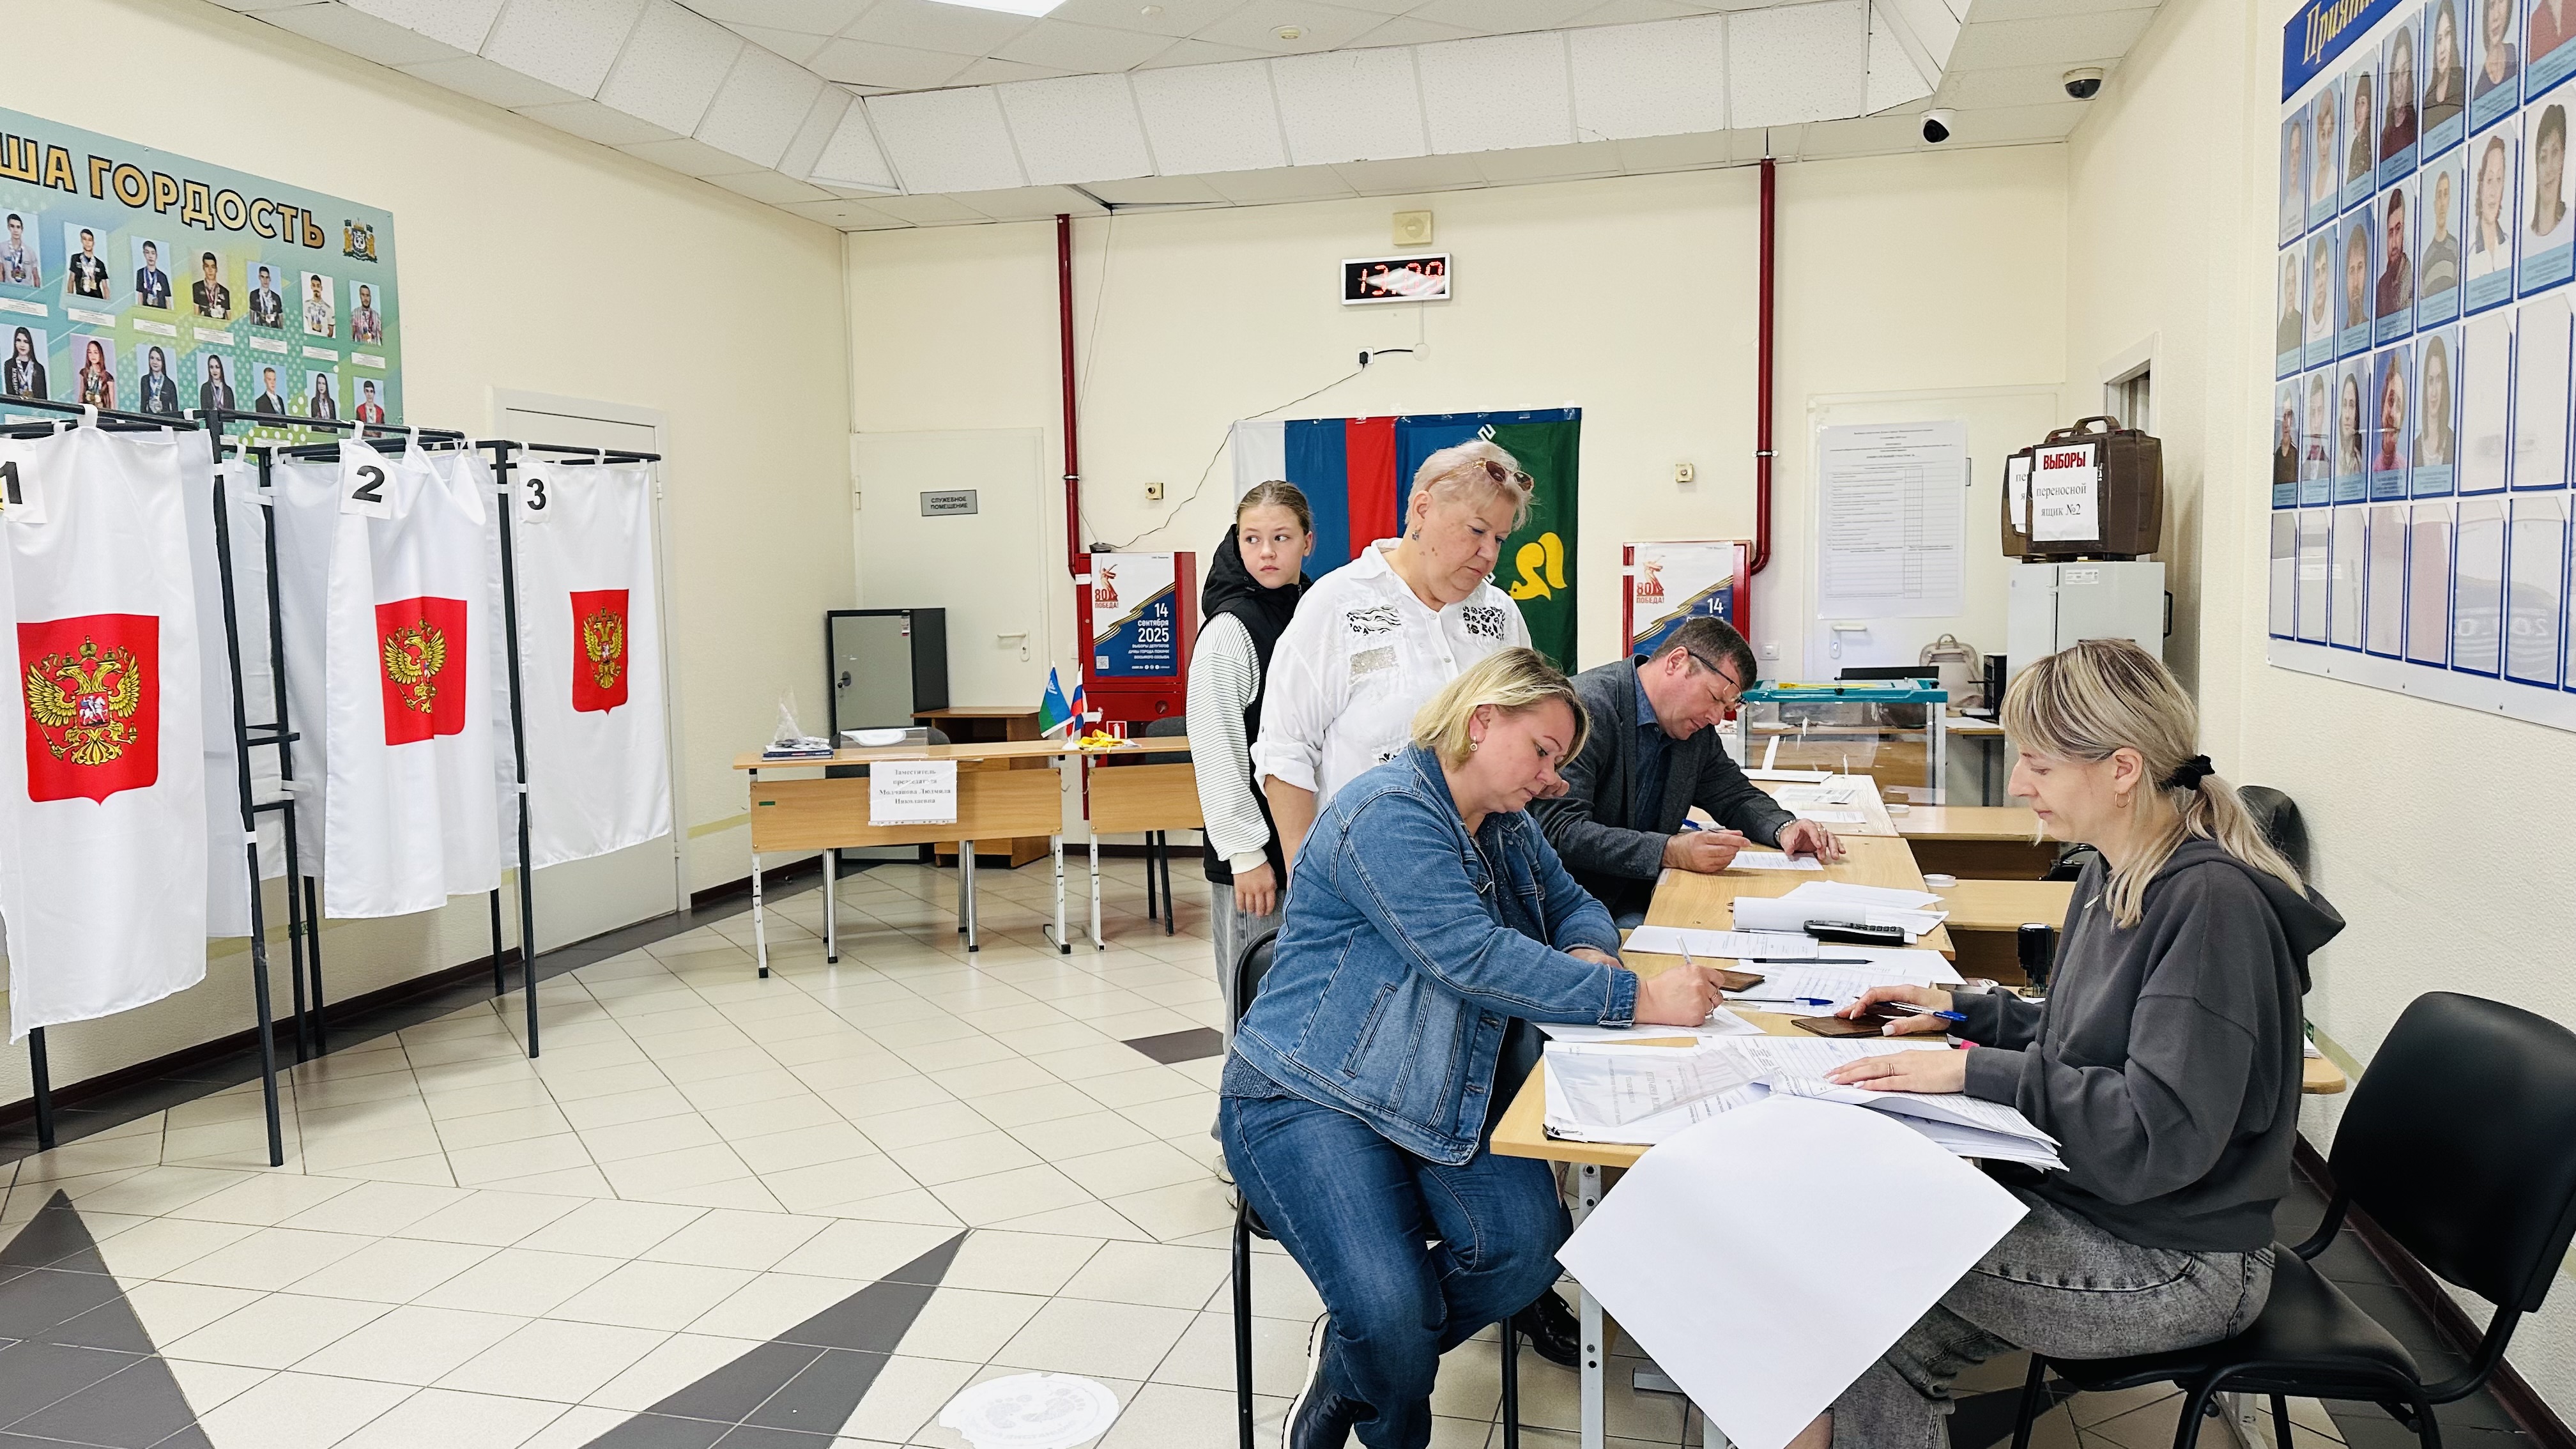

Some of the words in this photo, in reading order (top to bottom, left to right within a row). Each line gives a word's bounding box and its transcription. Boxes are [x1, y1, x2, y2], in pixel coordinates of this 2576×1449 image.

[0, 132, 77, 193] ША
[88, 153, 325, 249] ГОРДОСТЬ
[2043, 452, 2086, 470] ВЫБОРЫ
[0, 461, 22, 504] 1
[351, 465, 385, 503] 2
[526, 479, 546, 510] 3
[2037, 483, 2086, 499] переносной
[2041, 507, 2064, 517] ящик
[2066, 503, 2081, 515] №2
[1095, 589, 1107, 600] 80
[1637, 582, 1652, 595] 80
[1154, 603, 1169, 617] 14
[1707, 598, 1723, 613] 14
[1137, 618, 1169, 627] сентября
[1138, 628, 1169, 642] 2025
